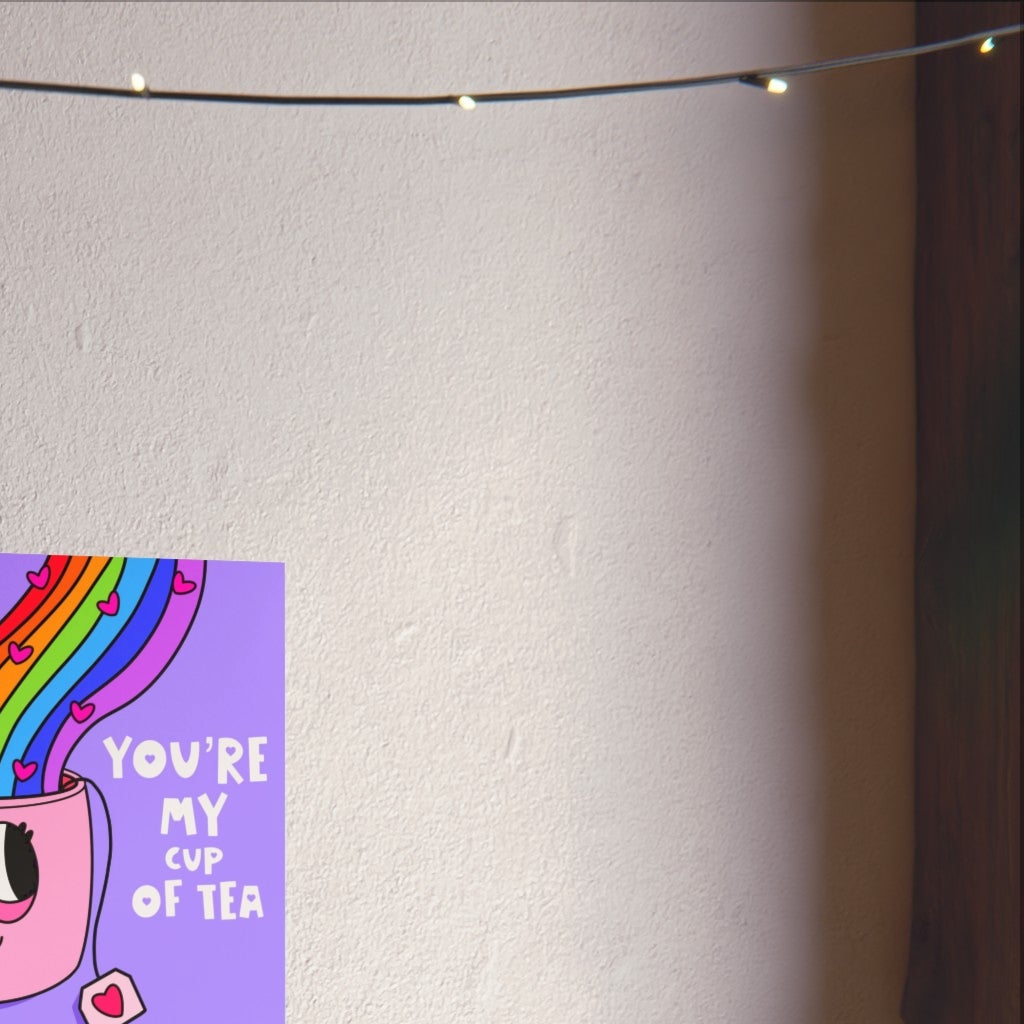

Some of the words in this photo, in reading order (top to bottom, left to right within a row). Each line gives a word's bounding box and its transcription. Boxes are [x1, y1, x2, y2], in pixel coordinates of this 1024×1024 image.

[102, 735, 268, 785] YOU'RE
[160, 791, 228, 837] MY
[165, 846, 224, 875] CUP
[131, 879, 182, 918] OF
[196, 880, 264, 920] TEA
